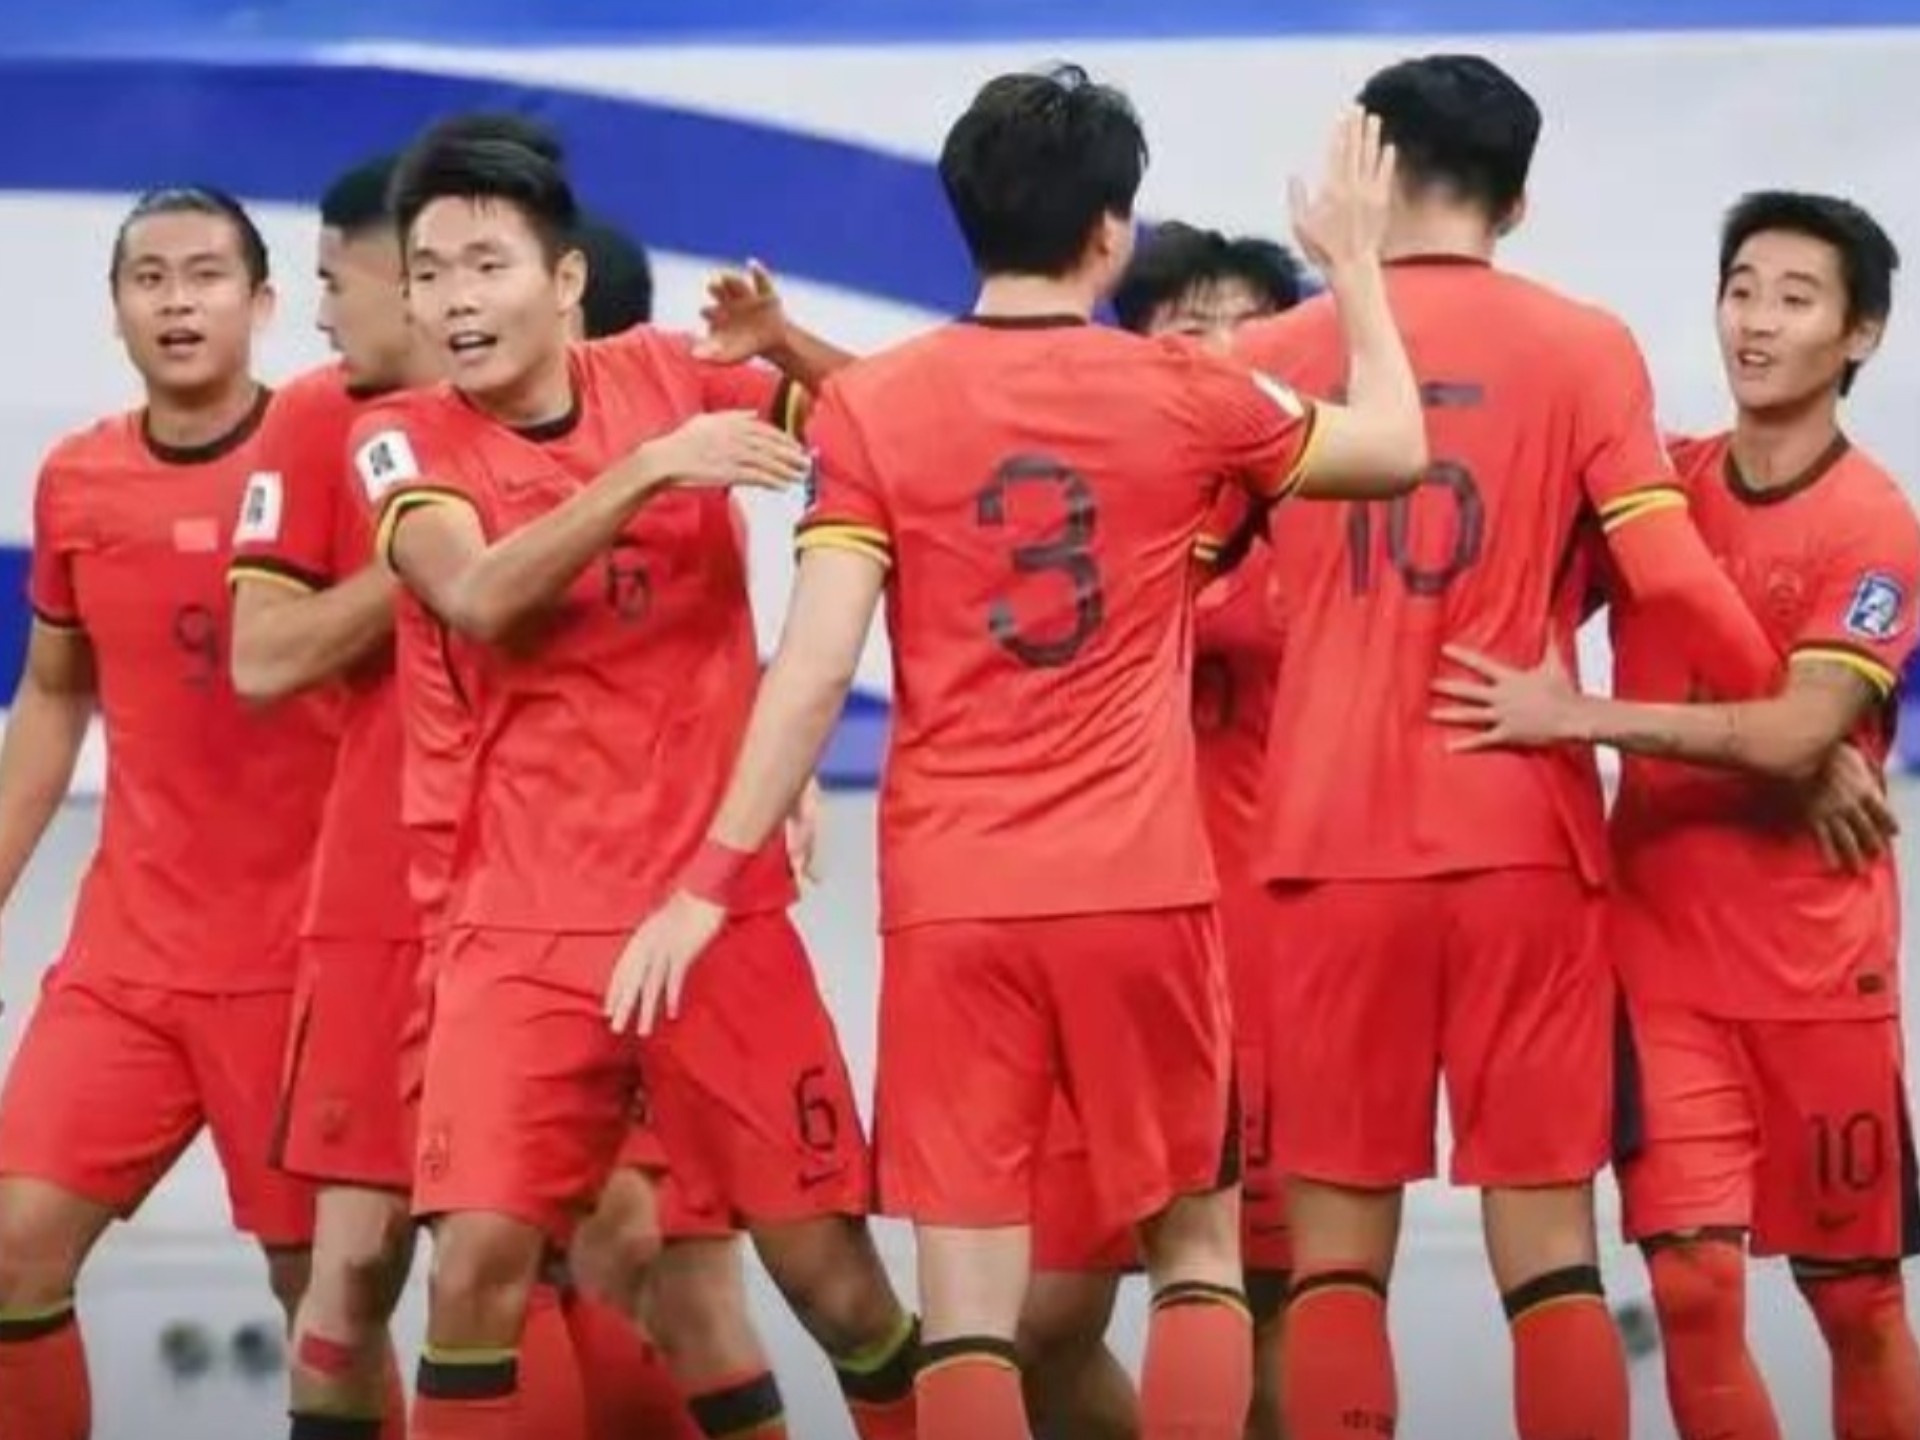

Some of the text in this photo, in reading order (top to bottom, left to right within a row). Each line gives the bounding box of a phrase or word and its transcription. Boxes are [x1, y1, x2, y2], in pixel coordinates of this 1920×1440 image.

[976, 454, 1105, 669] 3
[172, 603, 220, 686] 9
[793, 1066, 838, 1152] 6
[1809, 1111, 1884, 1193] 10
